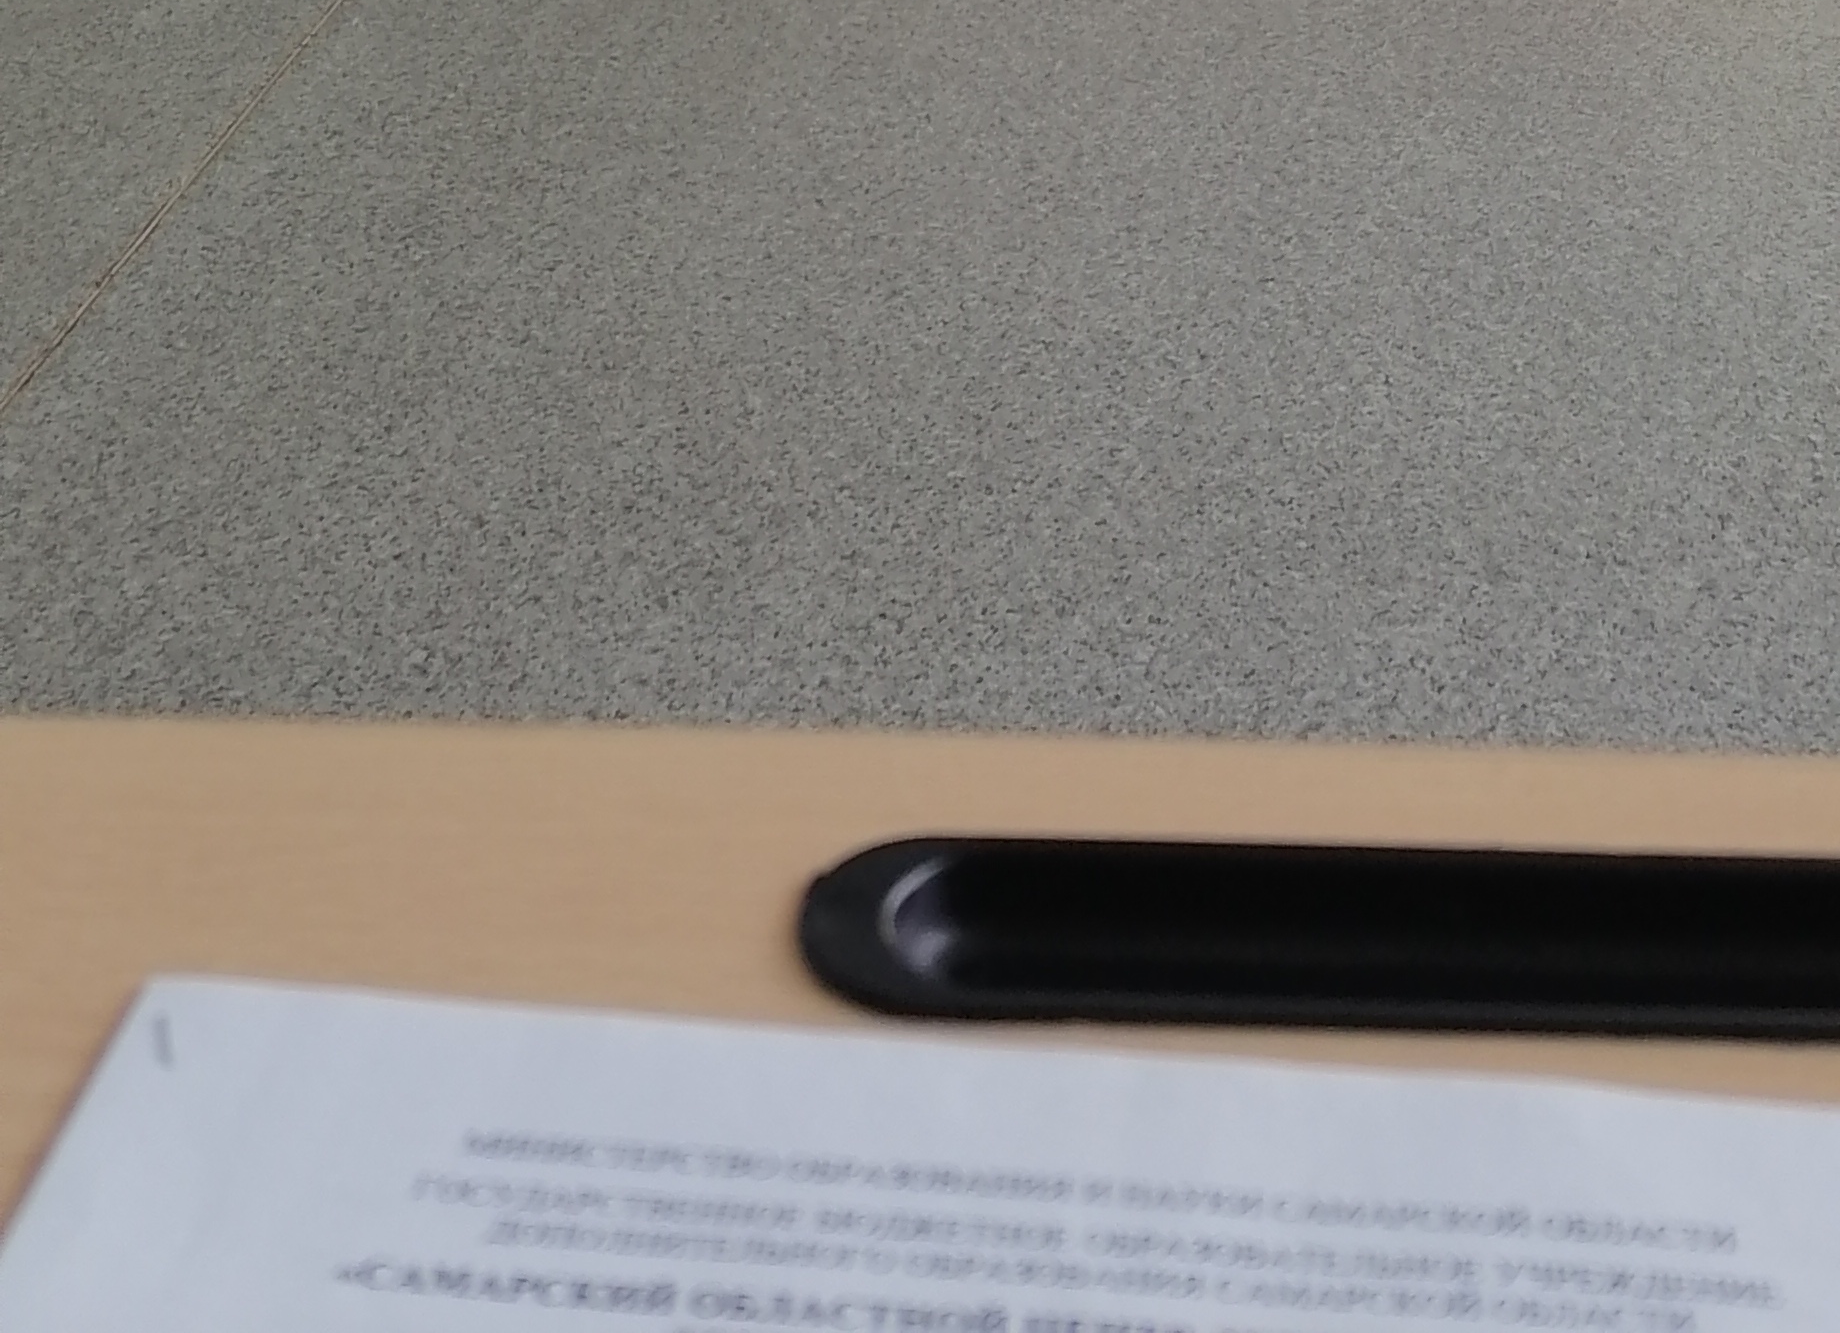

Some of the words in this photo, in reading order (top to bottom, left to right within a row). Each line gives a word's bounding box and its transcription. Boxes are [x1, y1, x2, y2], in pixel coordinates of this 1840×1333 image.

[411, 1170, 801, 1230] ГОСУДАРСТВЕННОЕ
[814, 1205, 1066, 1251] БЮДЖЕТНОЕ
[463, 1128, 781, 1181] МИНИСТЕРСТВО
[785, 1150, 1075, 1203] ОБРАЗОВАНИЯ
[1118, 1176, 1264, 1218] НАУКИ
[1271, 1191, 1530, 1236] САМАРСКОЙ
[1535, 1207, 1739, 1253] ОБЛАСТИ
[687, 1281, 1006, 1333] ОБЛАСТНОЙ
[902, 1247, 1204, 1298] ОБРАЗОВАНИЯ
[1210, 1270, 1481, 1320] САМАРСКОЙ
[1486, 1290, 1695, 1333] ОБЛАСТИ
